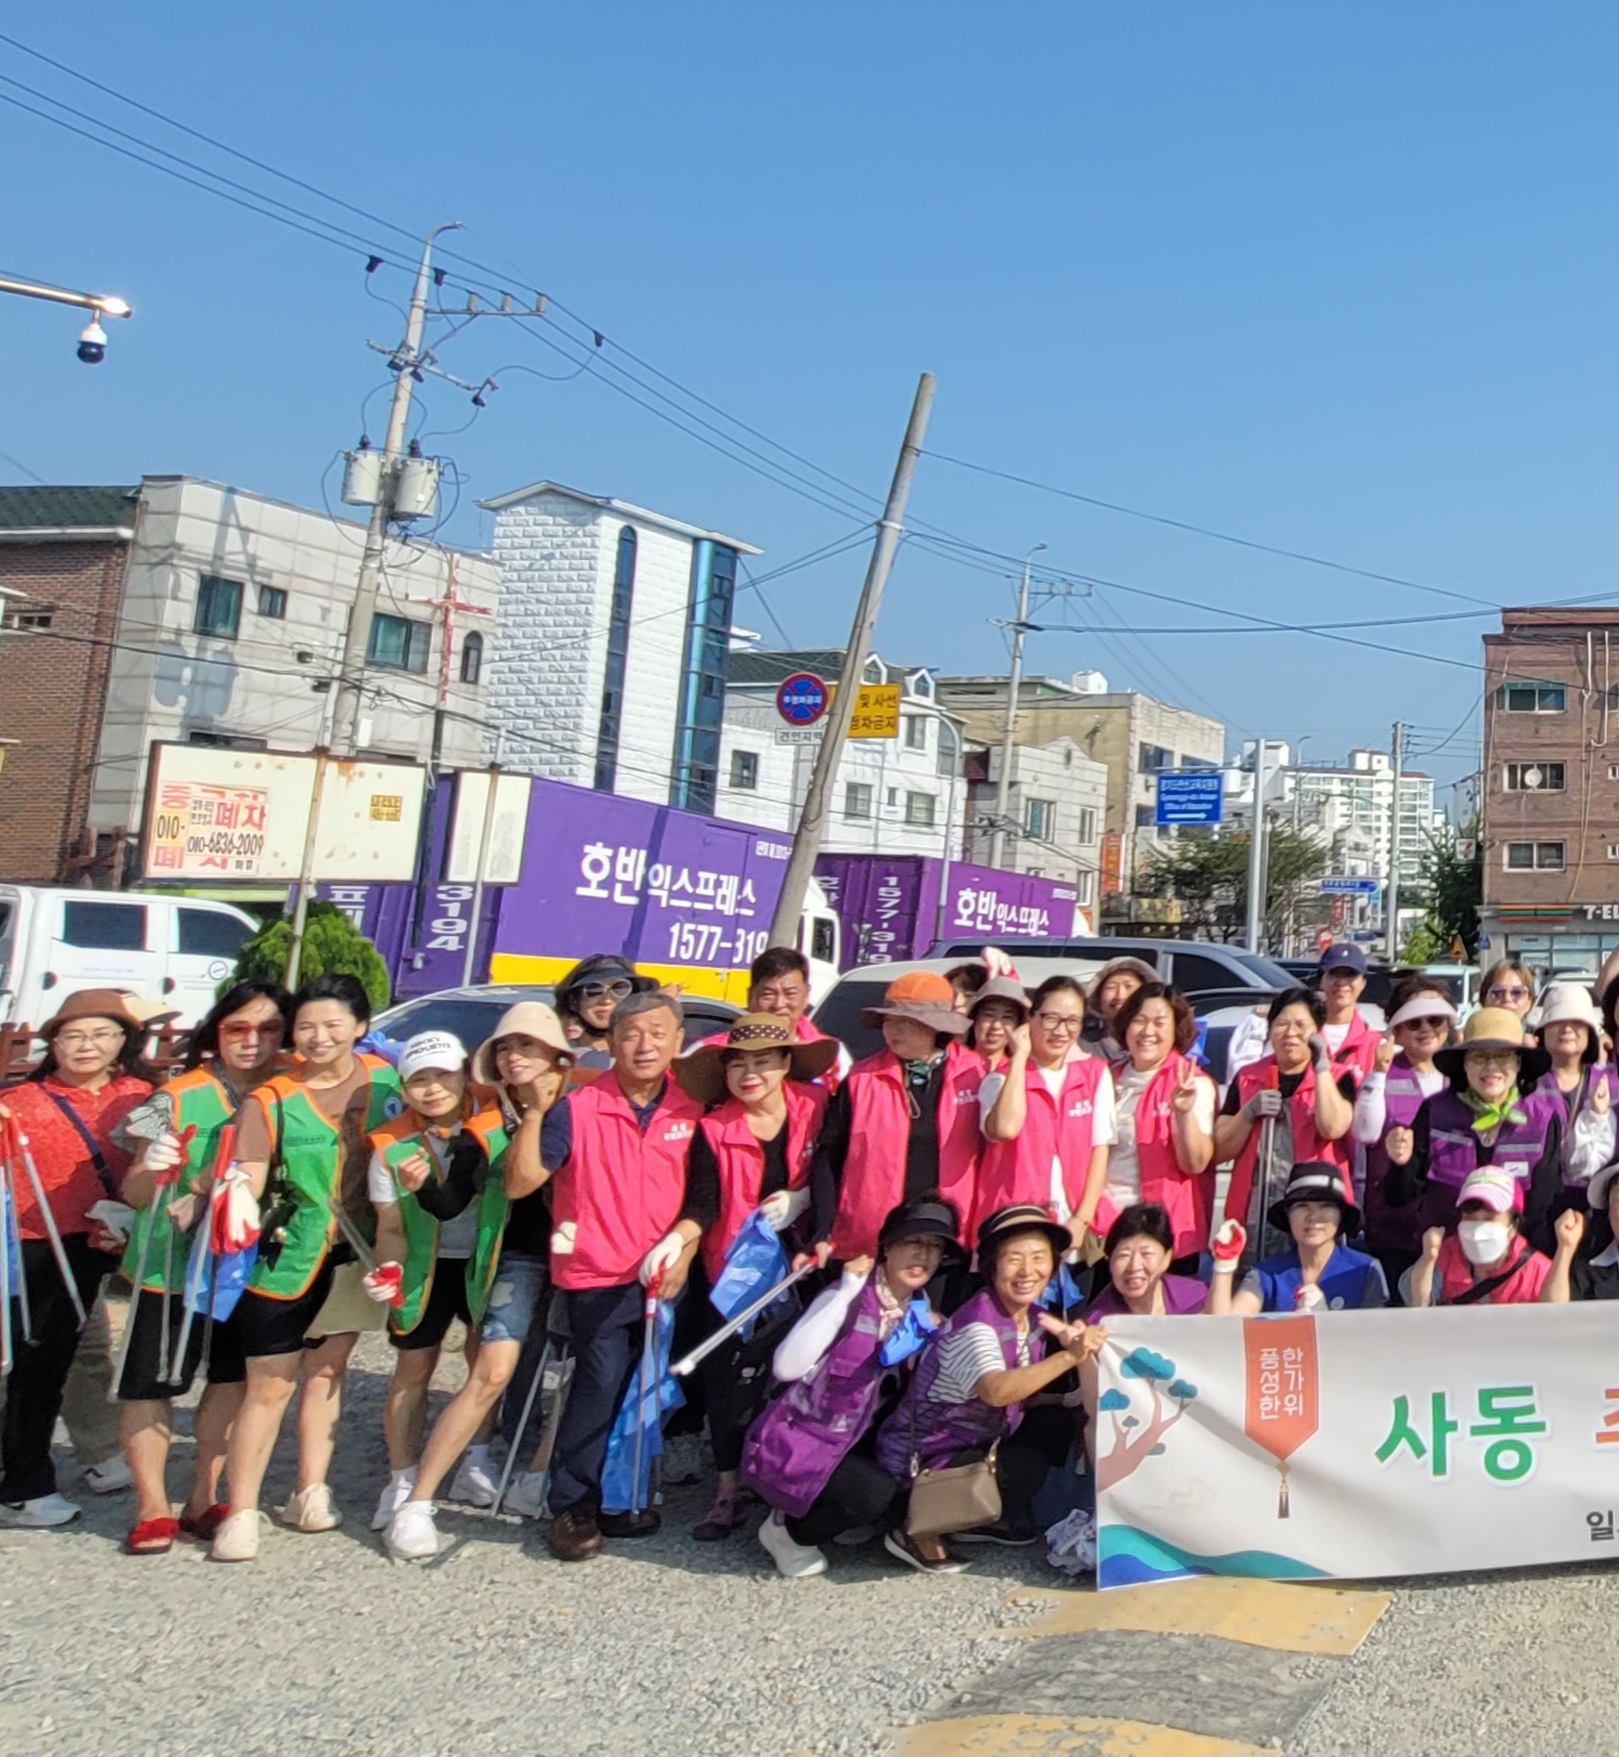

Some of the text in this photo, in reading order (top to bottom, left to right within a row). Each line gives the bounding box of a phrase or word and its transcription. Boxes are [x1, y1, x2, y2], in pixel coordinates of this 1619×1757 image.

[668, 921, 769, 964] 1577-319
[1259, 1347, 1281, 1420] 풍성한
[1282, 1346, 1305, 1418] 한가위
[1374, 1384, 1549, 1483] 사동
